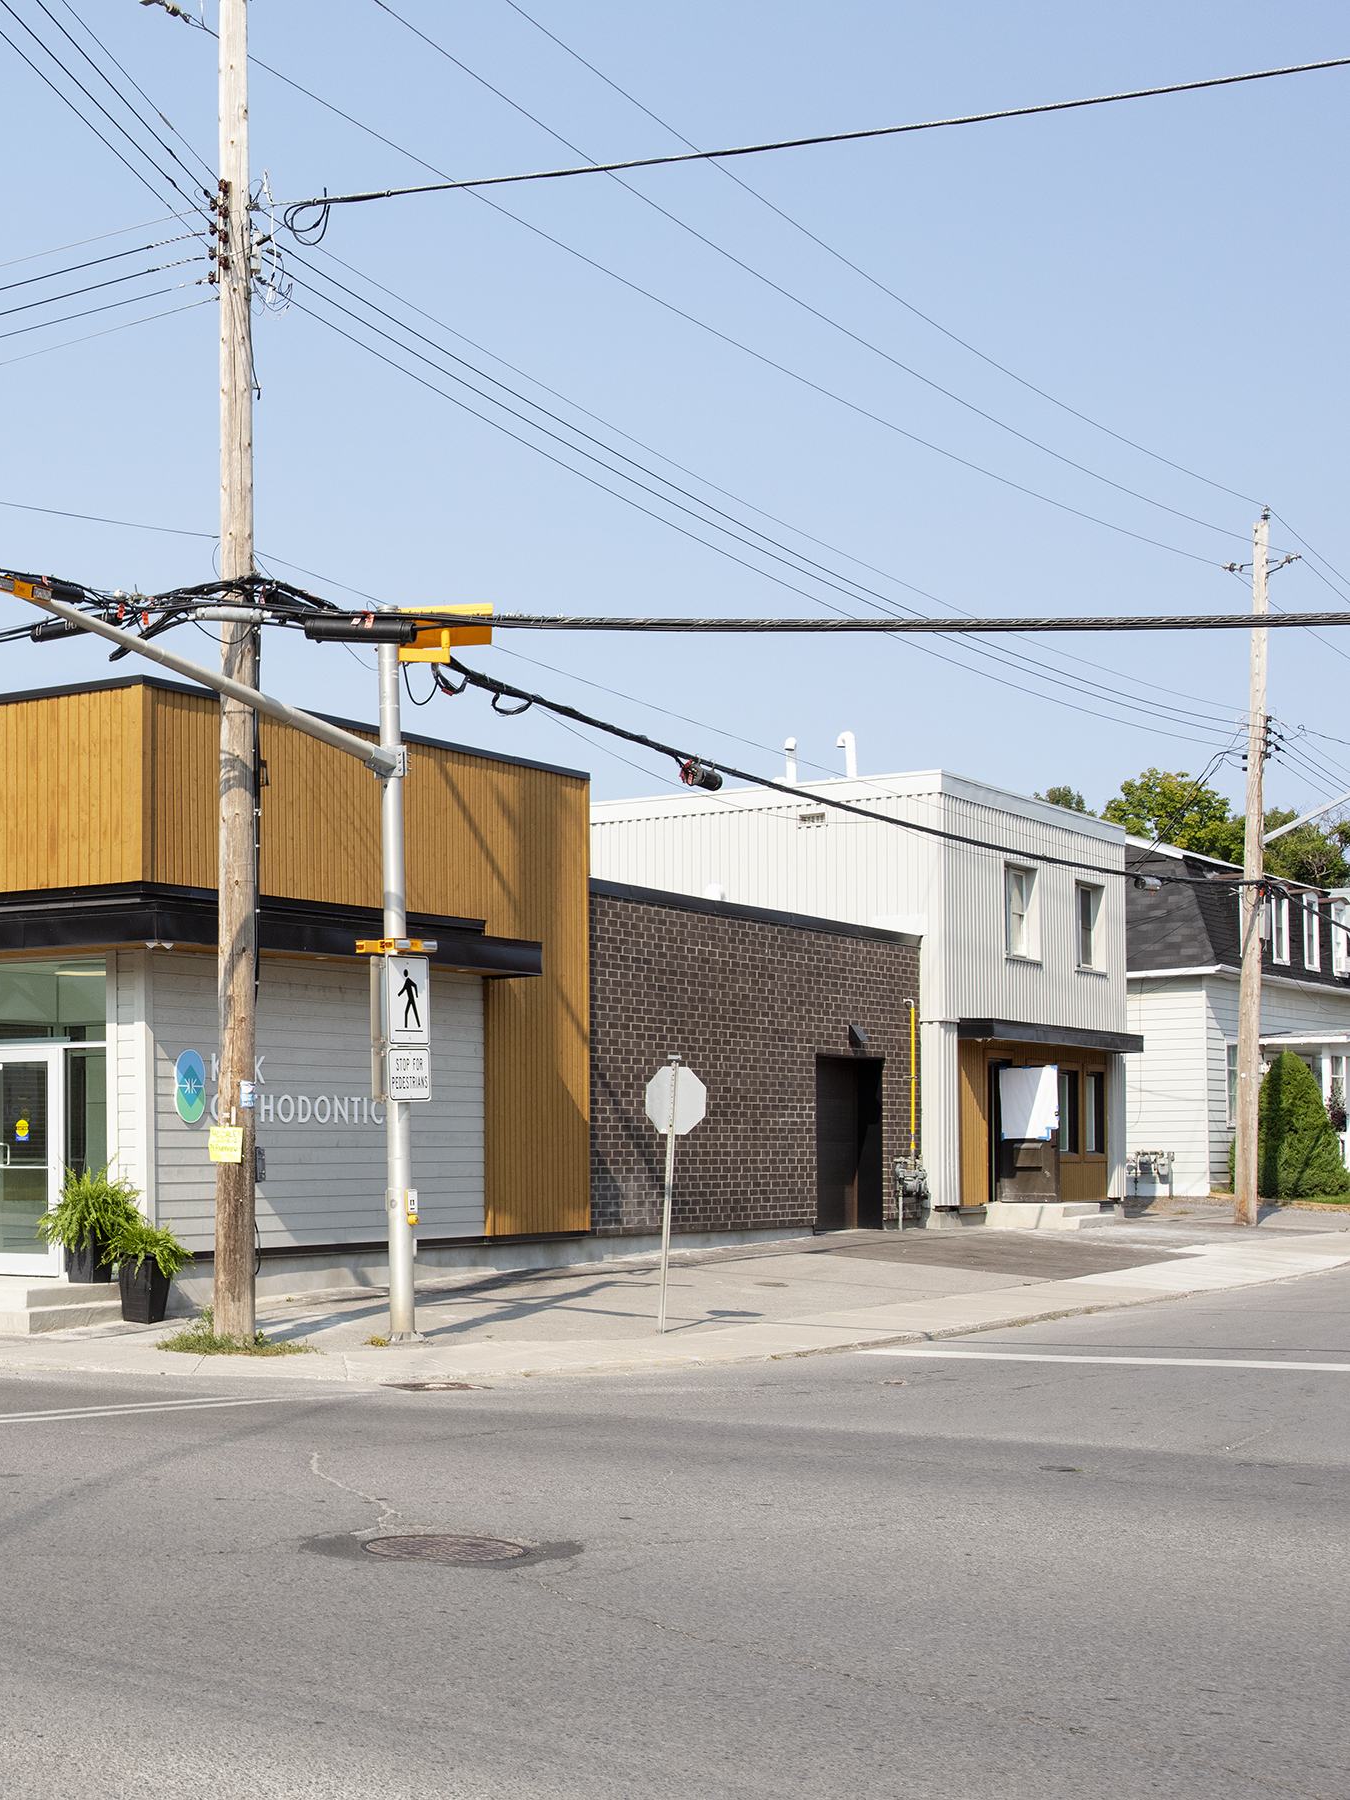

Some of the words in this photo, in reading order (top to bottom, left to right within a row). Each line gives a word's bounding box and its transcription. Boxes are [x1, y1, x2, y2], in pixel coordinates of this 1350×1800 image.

[211, 1052, 266, 1084] KK
[395, 1057, 411, 1071] STOP
[412, 1057, 424, 1071] FOR
[391, 1075, 429, 1090] PEDESTRIANS
